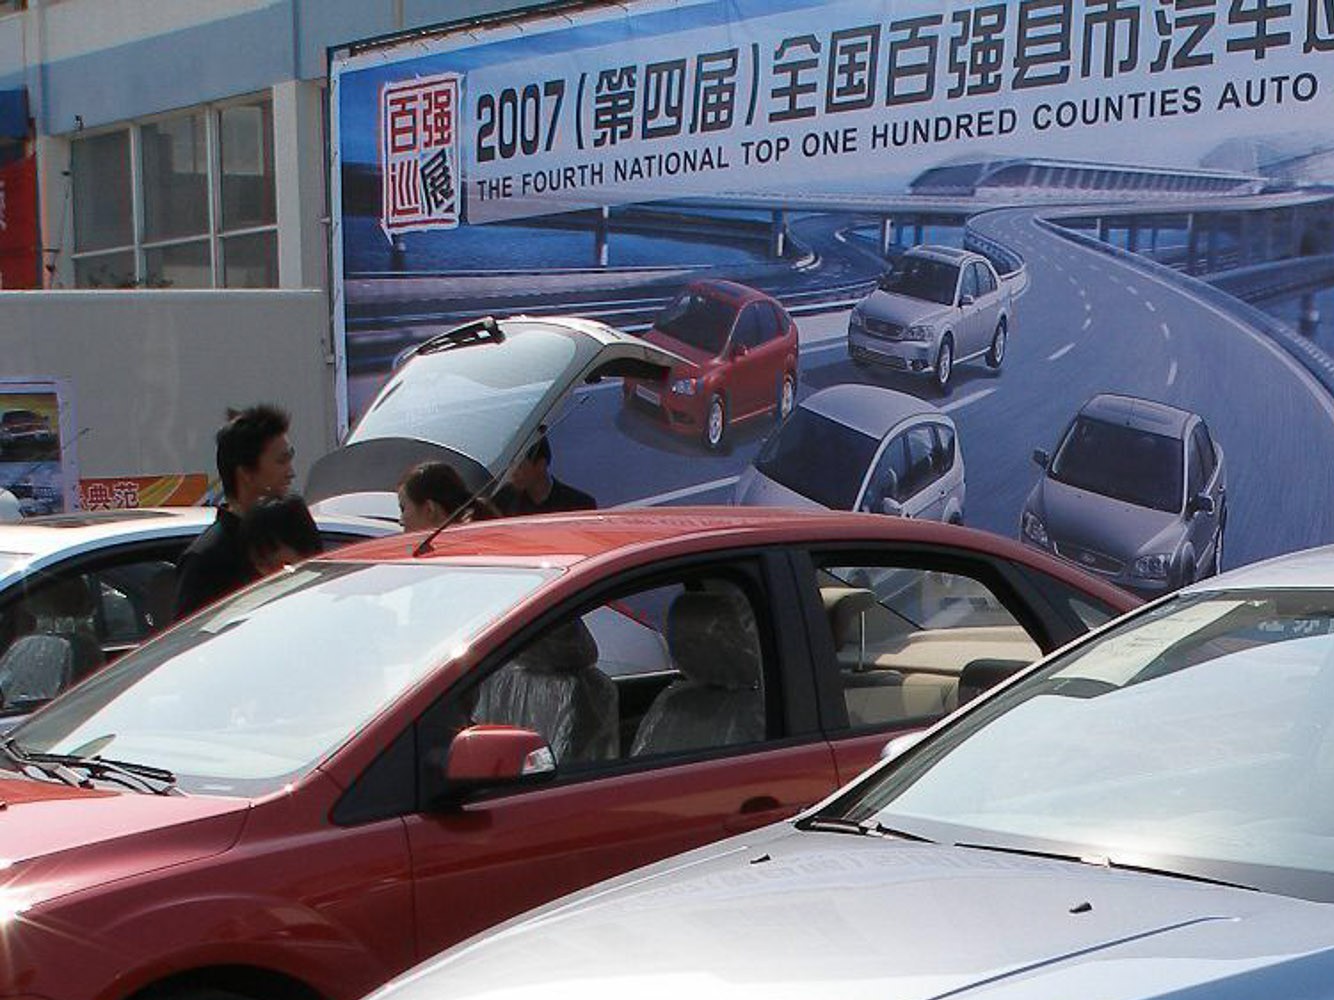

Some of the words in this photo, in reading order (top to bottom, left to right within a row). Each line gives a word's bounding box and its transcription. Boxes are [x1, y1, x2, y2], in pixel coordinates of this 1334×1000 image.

[389, 89, 451, 154] 百强
[477, 176, 512, 202] THE
[522, 163, 604, 195] FOURTH
[614, 146, 729, 182] NATIONAL
[741, 137, 790, 165] TOP
[803, 128, 858, 157] ONE
[871, 108, 1017, 150] HUNDRED
[1033, 85, 1201, 130] COUNTIES
[1217, 72, 1318, 111] AUTO
[81, 482, 140, 511] 典范
